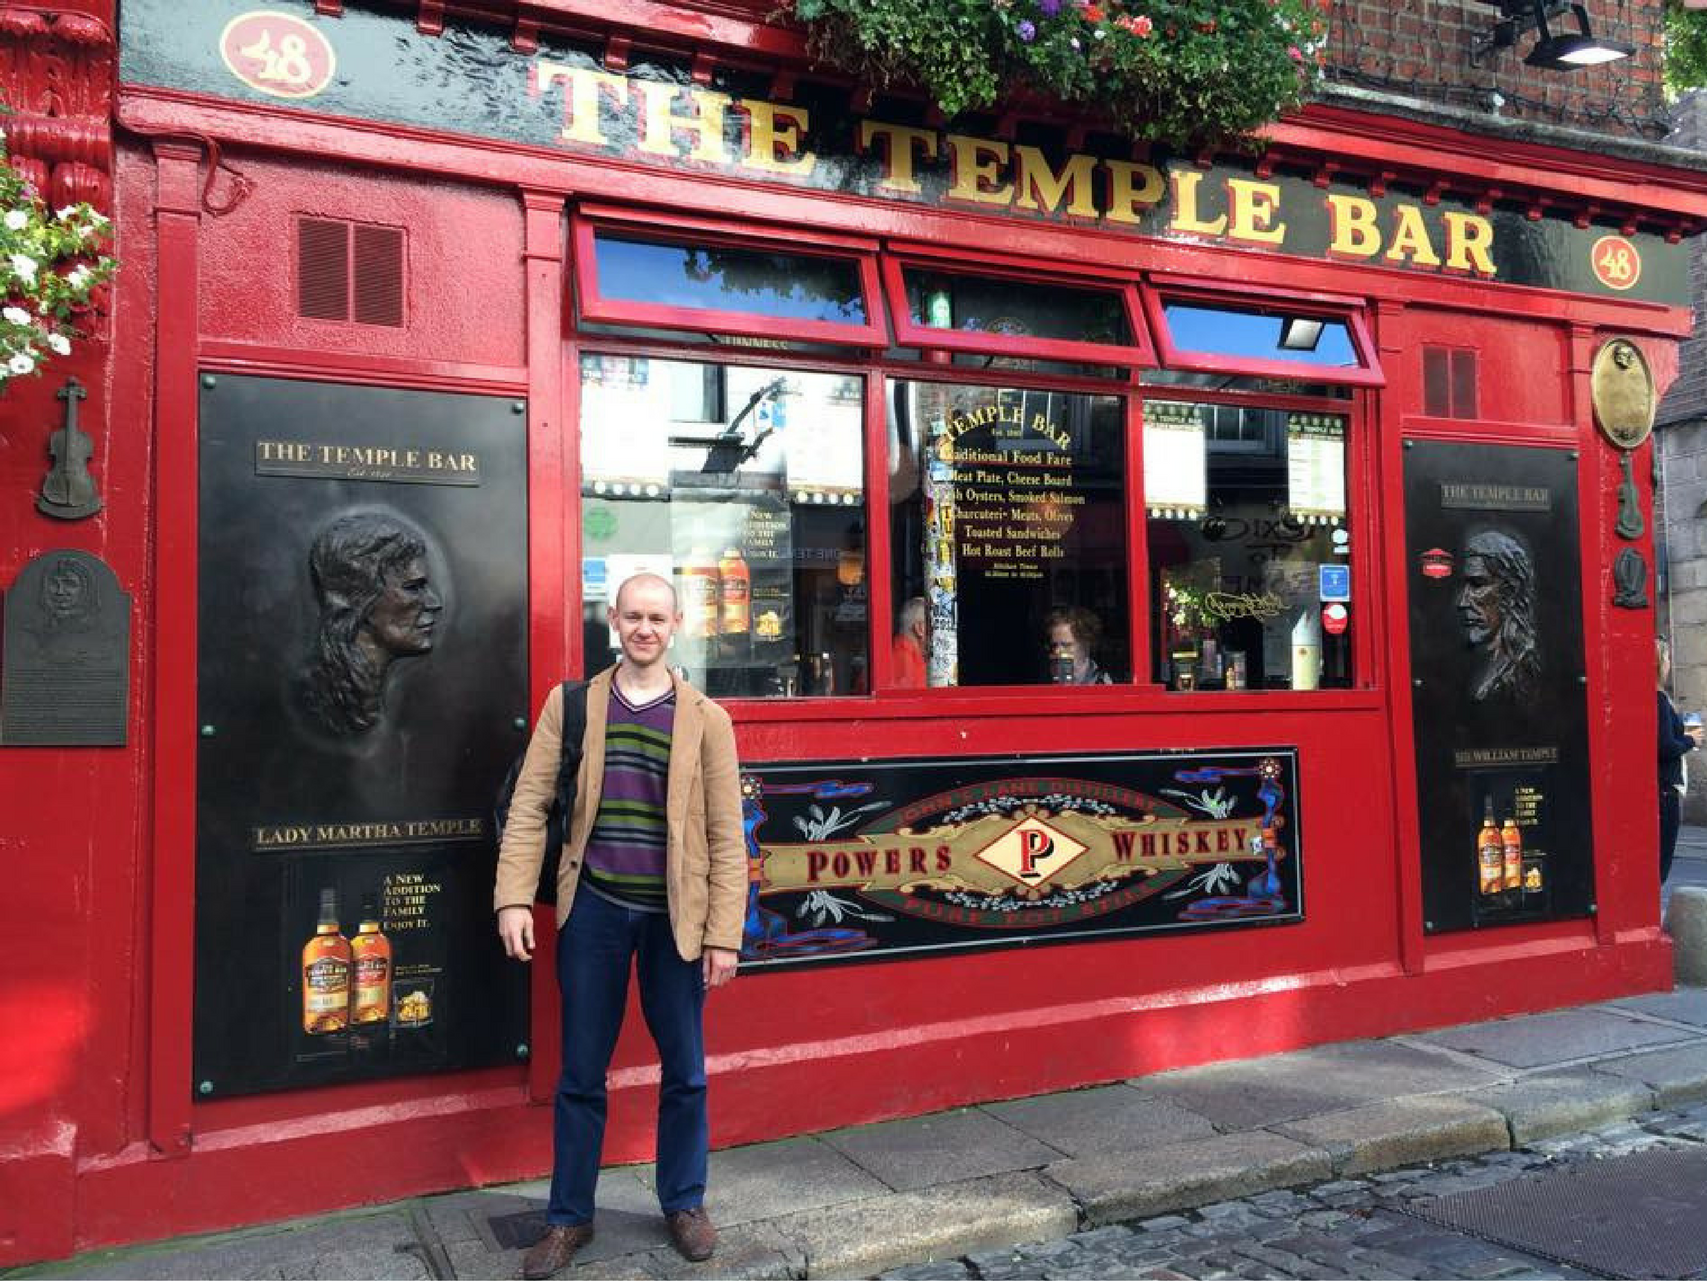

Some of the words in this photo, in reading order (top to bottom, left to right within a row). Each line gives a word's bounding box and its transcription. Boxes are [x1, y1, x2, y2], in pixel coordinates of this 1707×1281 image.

[241, 28, 311, 84] 48
[533, 60, 817, 177] THE
[862, 120, 1287, 247] TEMPLE
[1325, 193, 1498, 276] BAR
[1600, 244, 1632, 281] 48
[1031, 413, 1072, 451] BAR
[258, 441, 312, 462] THE
[318, 445, 421, 468] TEMPLE
[427, 452, 477, 472] BAR
[941, 448, 1008, 463] aditional
[1013, 451, 1042, 464] Food
[1046, 451, 1072, 465] Fare
[1006, 471, 1040, 486] Cheese
[1043, 473, 1073, 487] Board
[1008, 489, 1047, 503] Smoked
[1049, 491, 1086, 504] Salmon
[965, 525, 1003, 538] Toasted
[1006, 525, 1061, 540] Sandwiches
[961, 543, 982, 556] Hot
[984, 544, 1012, 556] Roast
[1015, 544, 1037, 557] Beef
[1040, 545, 1065, 558] Rolls
[257, 827, 312, 845] LADY
[316, 822, 403, 842] MARTHA
[405, 818, 483, 837] TEMPLE
[806, 845, 953, 882] POWERS
[1016, 829, 1056, 878] P
[1111, 827, 1249, 863] WHISKEY
[384, 884, 442, 895] ADDITION
[384, 896, 402, 906] TO
[404, 895, 427, 905] THE
[384, 905, 426, 917] FAMILY
